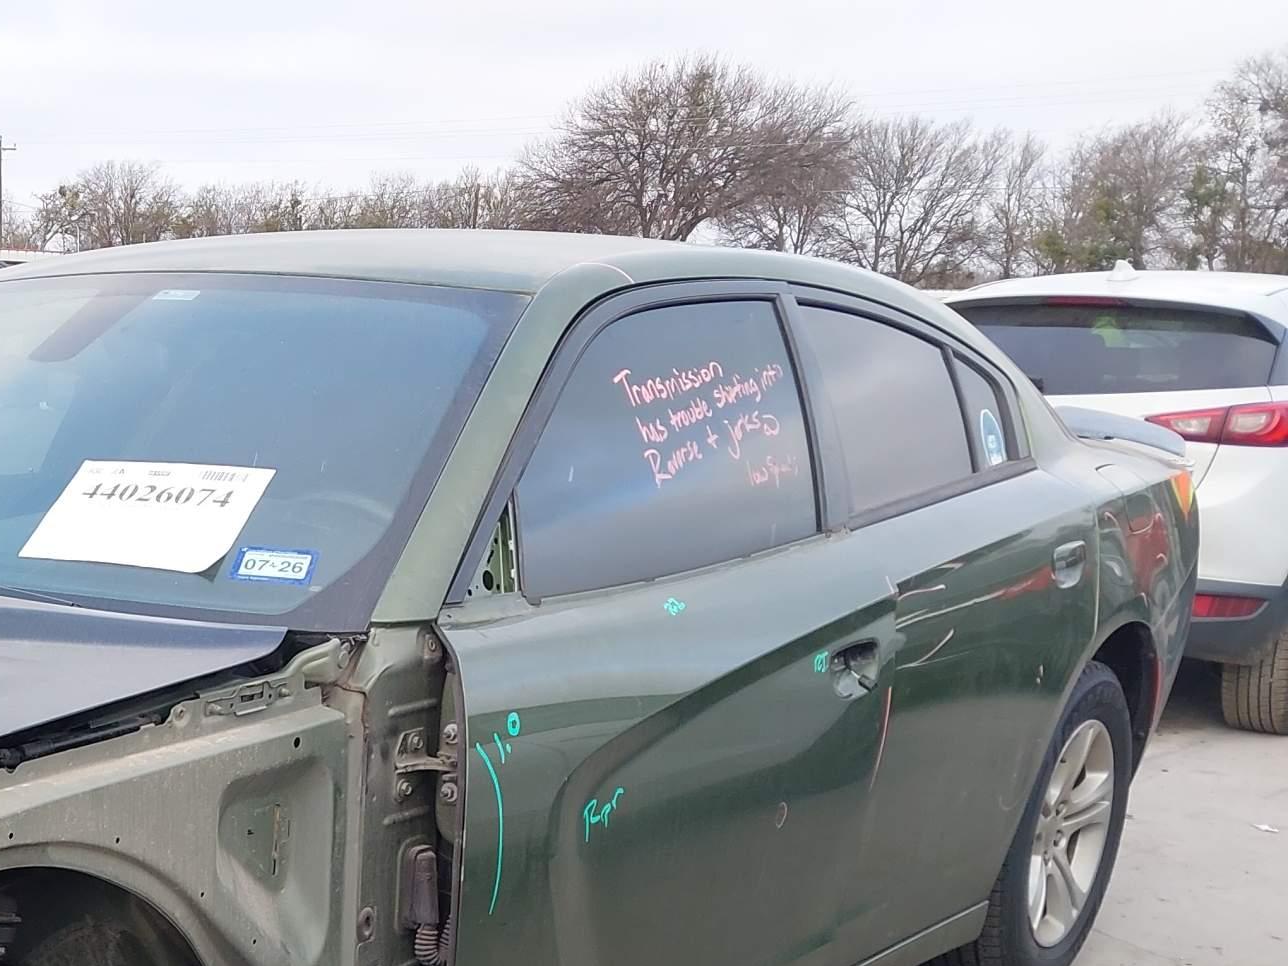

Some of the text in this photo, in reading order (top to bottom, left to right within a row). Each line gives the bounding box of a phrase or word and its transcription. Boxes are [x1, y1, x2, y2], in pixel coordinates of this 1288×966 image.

[613, 361, 725, 407] Transmission
[635, 416, 668, 444] has
[667, 398, 713, 432] trouble
[81, 482, 235, 508] 44026074
